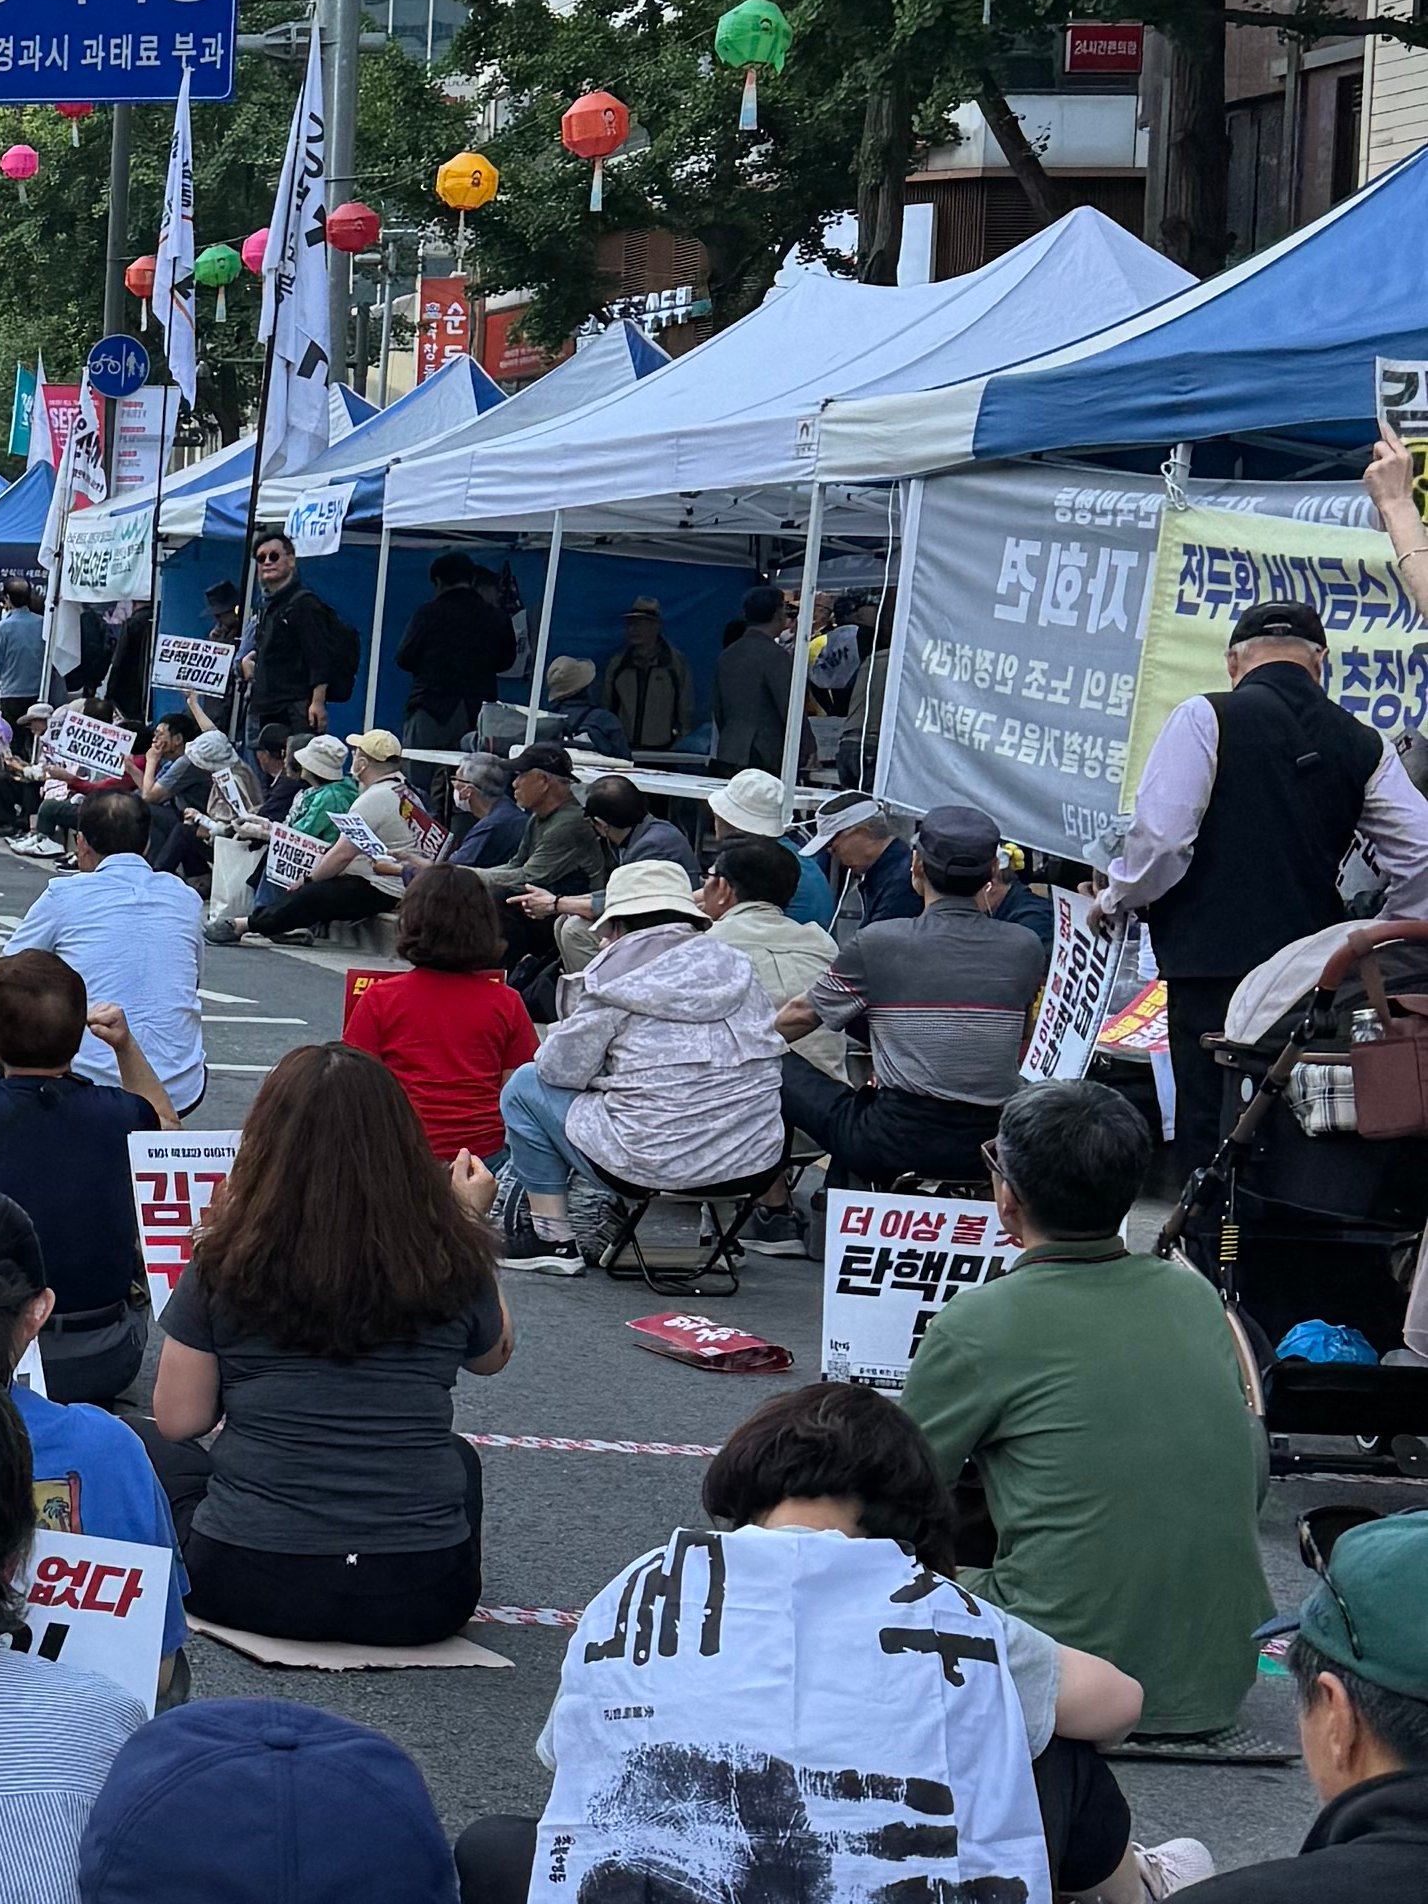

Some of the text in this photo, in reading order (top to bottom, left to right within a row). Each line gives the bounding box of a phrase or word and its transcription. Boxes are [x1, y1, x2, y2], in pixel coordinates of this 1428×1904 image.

[80, 34, 162, 72] 과태료
[171, 32, 225, 72] 부과
[1175, 542, 1262, 621] 전두환
[158, 648, 218, 670] 탄핵만이
[1043, 929, 1092, 1078] 탄핵만이
[838, 1205, 872, 1236] 더
[878, 1209, 947, 1243] 이상
[953, 1215, 991, 1247] 볼
[835, 1243, 1010, 1303] 탄핵만
[26, 1554, 144, 1619] 없다
